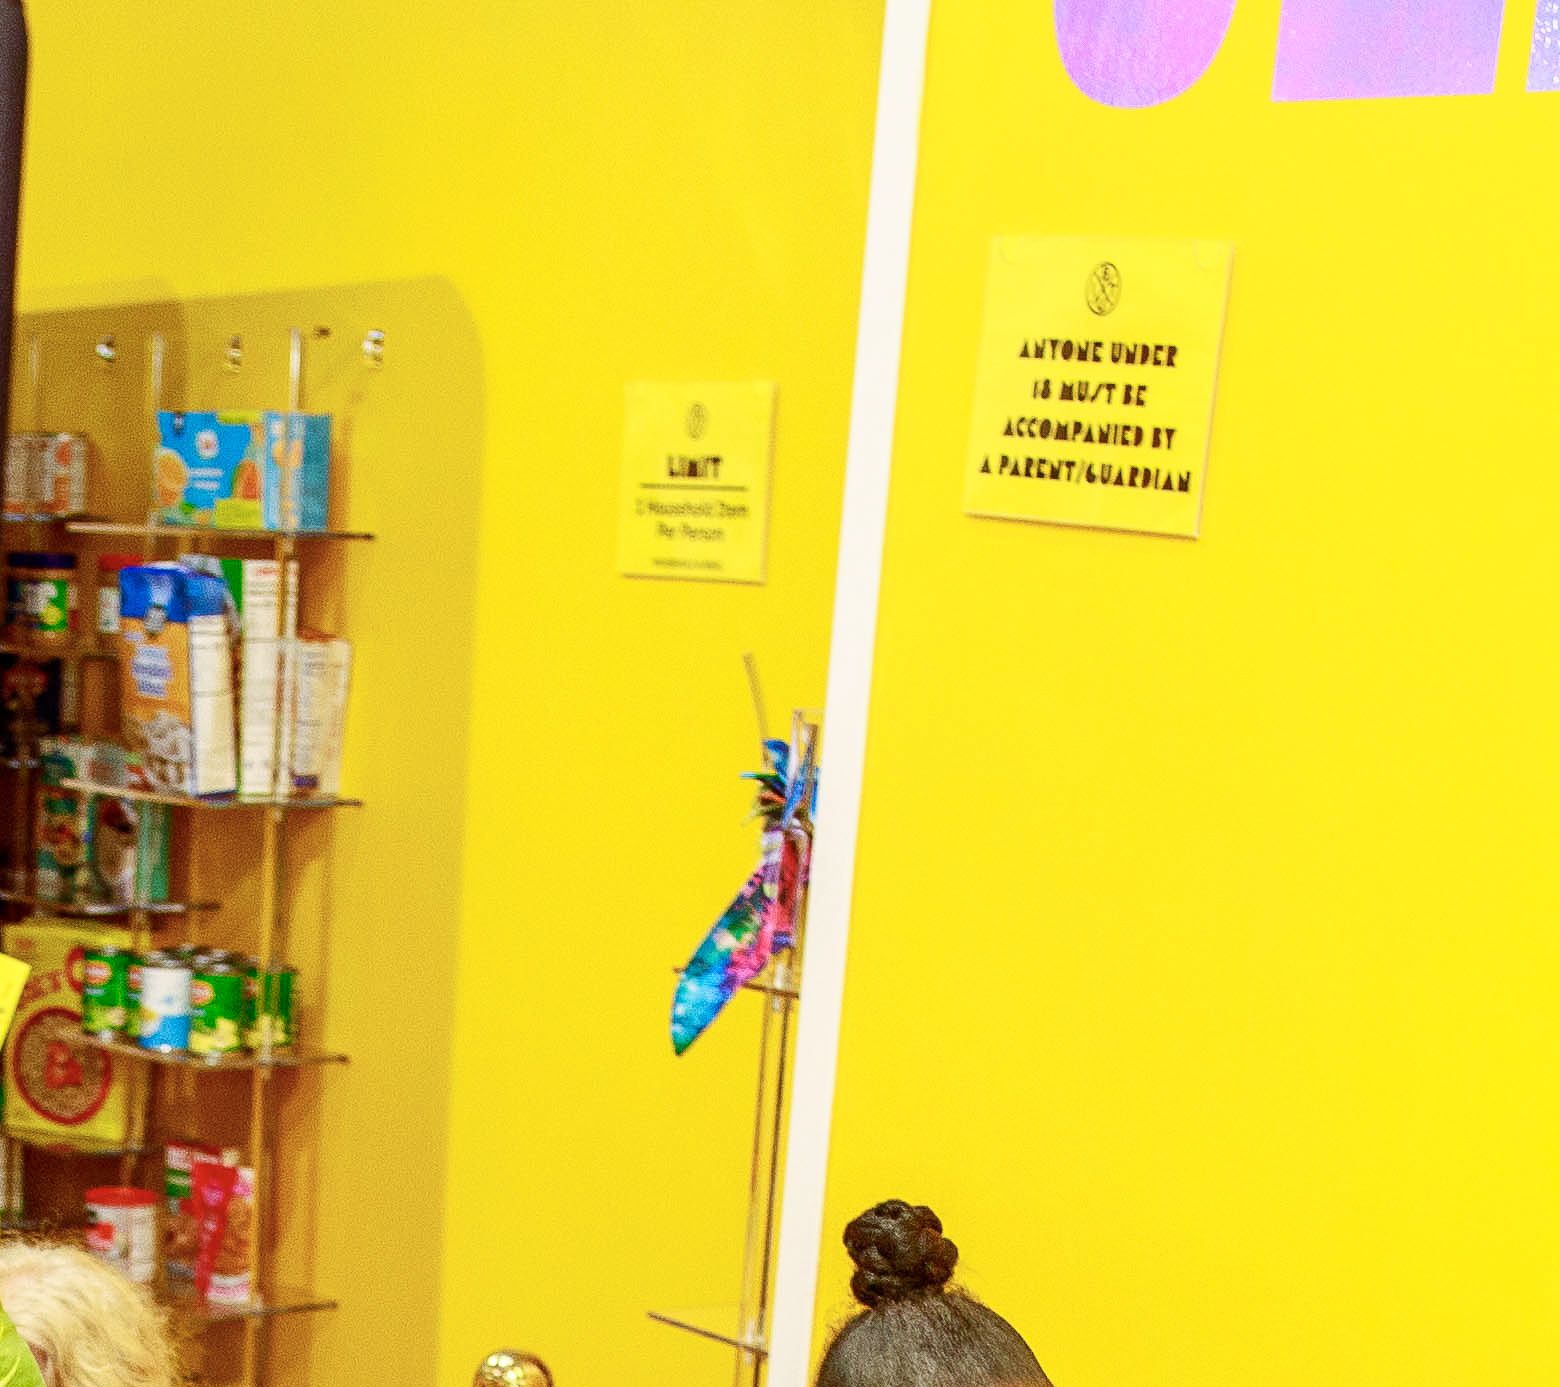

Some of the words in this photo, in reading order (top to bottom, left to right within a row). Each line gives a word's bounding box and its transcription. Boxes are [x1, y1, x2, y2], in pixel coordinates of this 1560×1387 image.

[1019, 338, 1103, 362] ANYONE
[1111, 343, 1178, 367] UNDER
[1033, 379, 1051, 399] 18
[1060, 380, 1116, 404] MUST
[1123, 384, 1147, 406] BE
[1003, 416, 1143, 447] ACCOMPANIED
[1151, 427, 1176, 449] BY
[667, 455, 722, 478] LIMIT
[979, 456, 991, 474] A
[998, 456, 1191, 493] PARENT/GUARDIAN
